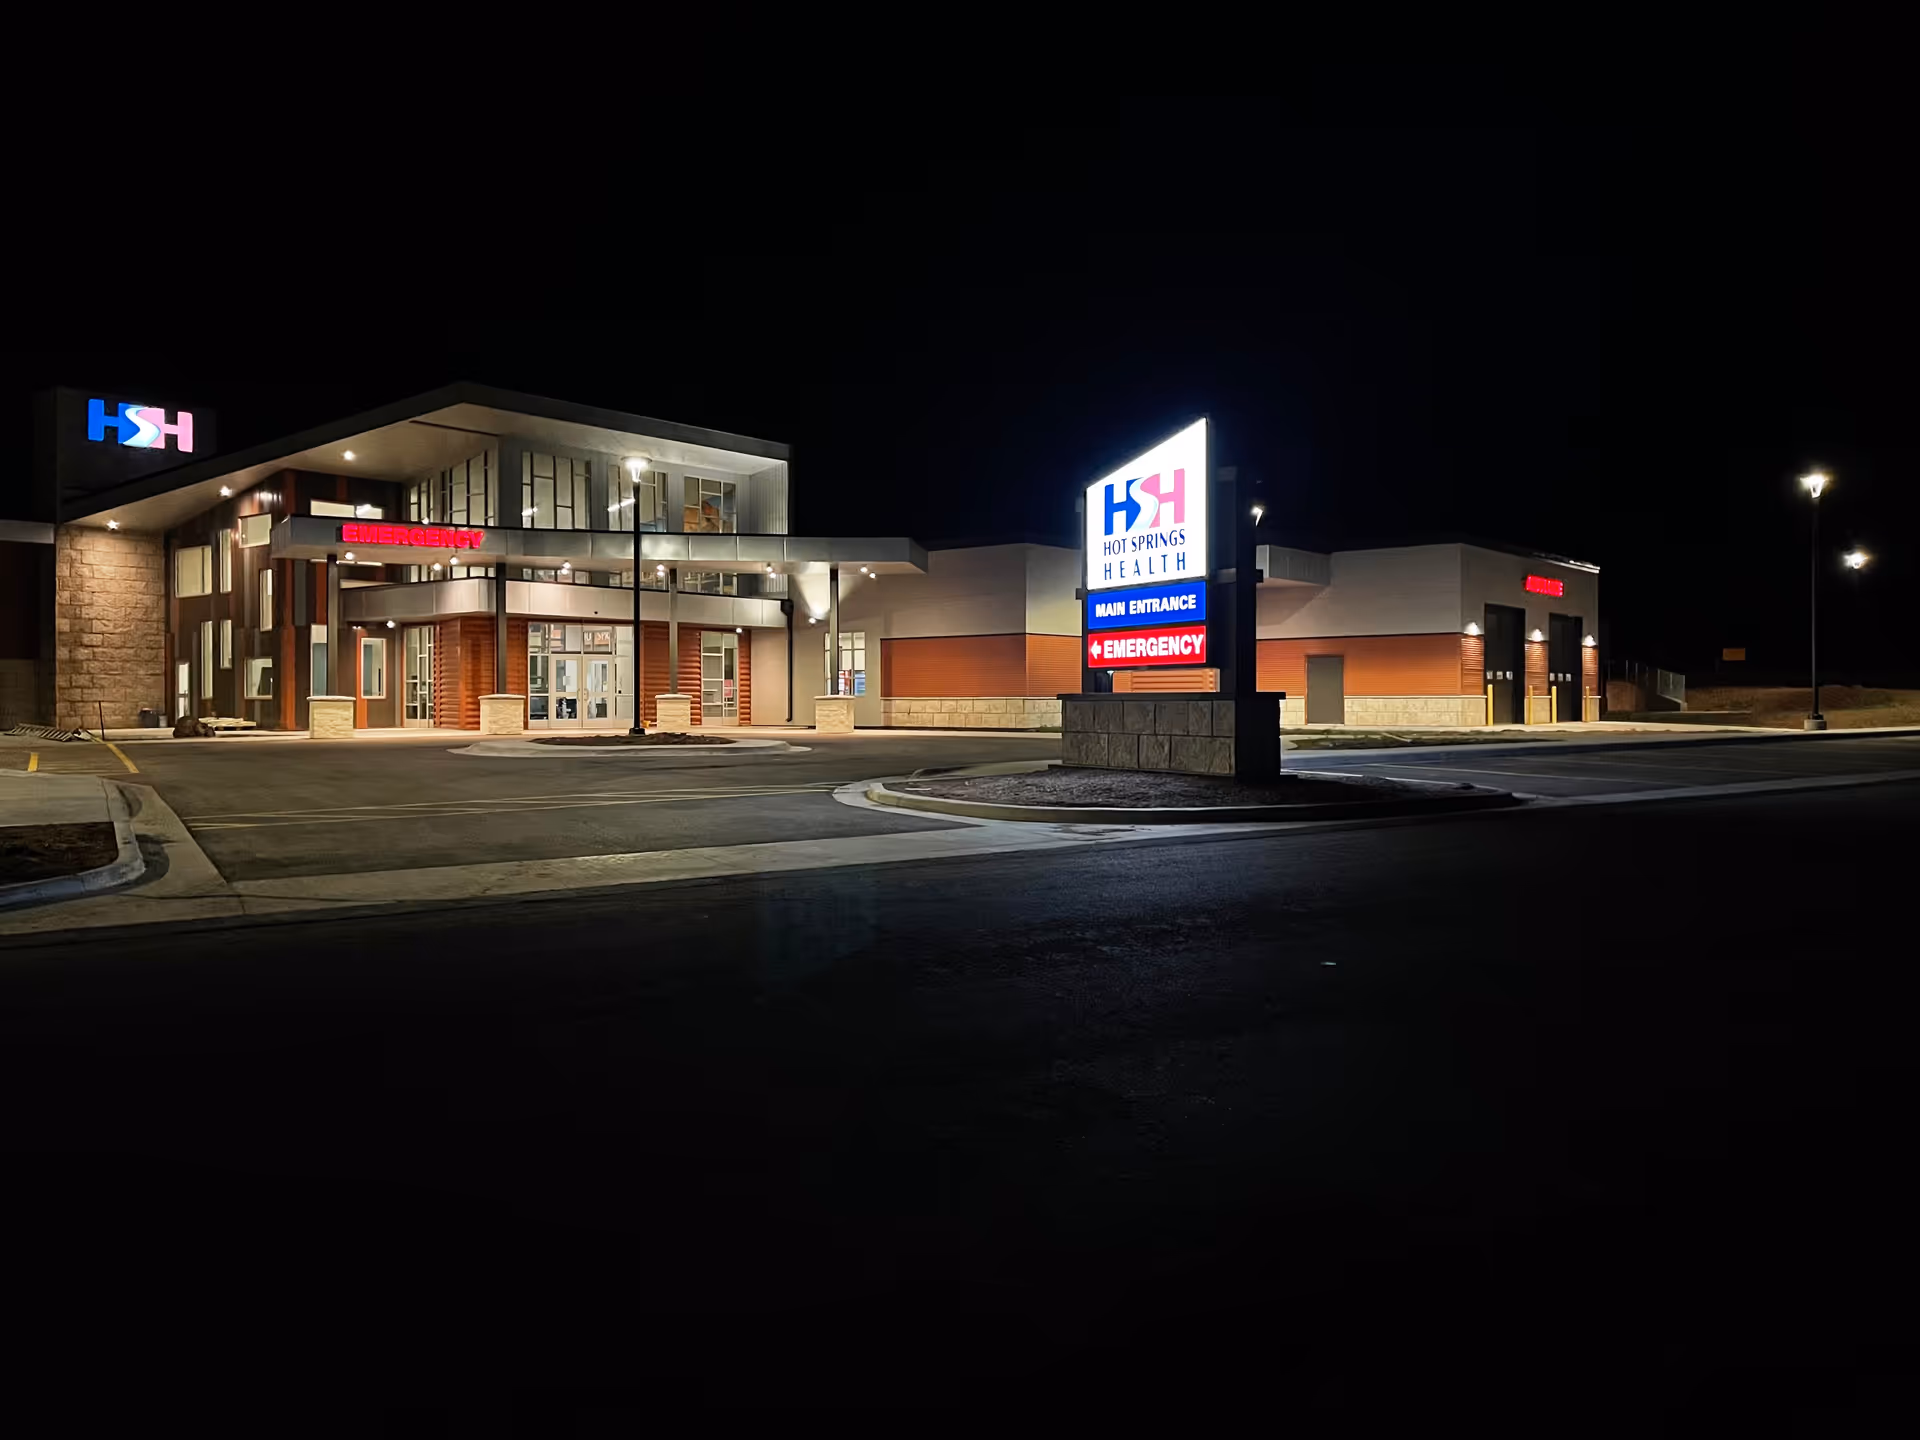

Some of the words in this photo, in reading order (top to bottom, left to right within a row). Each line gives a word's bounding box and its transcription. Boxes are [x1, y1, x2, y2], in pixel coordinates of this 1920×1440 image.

[88, 398, 193, 453] HSH
[1104, 468, 1185, 536] HSH
[342, 524, 484, 549] EMERGENCY
[1104, 539, 1127, 556] HOT
[1131, 529, 1185, 553] SPRINGS
[1104, 552, 1186, 580] HEALTH
[1095, 602, 1126, 618] MAIN
[1129, 595, 1197, 615] ENTRANCE
[1103, 634, 1204, 659] EMERGENCY
